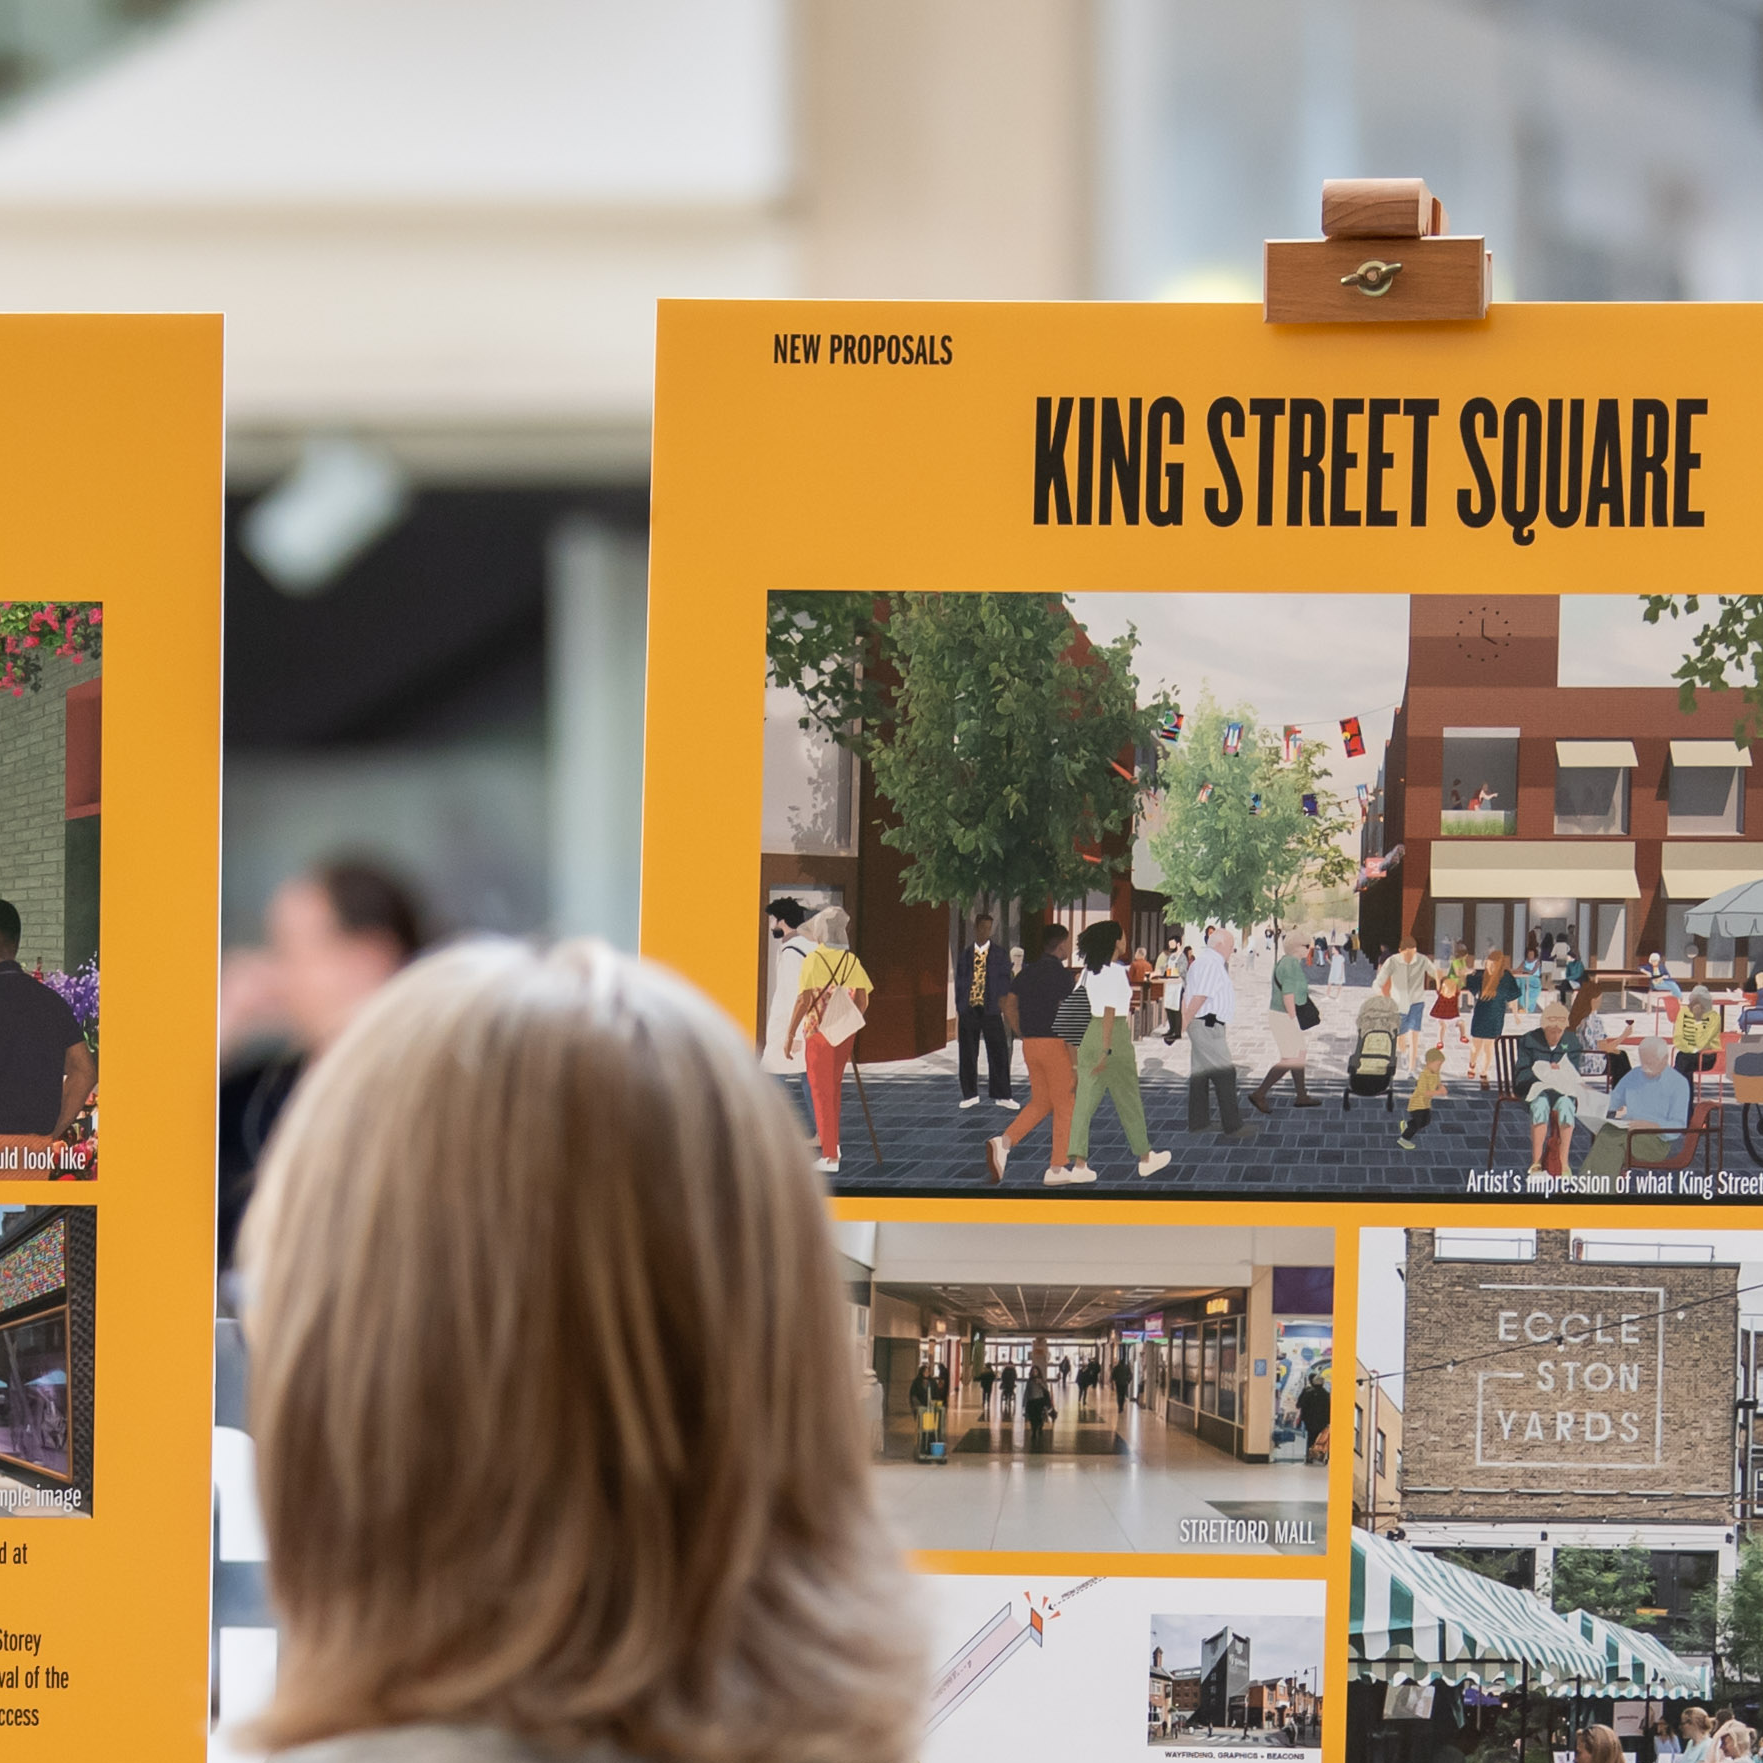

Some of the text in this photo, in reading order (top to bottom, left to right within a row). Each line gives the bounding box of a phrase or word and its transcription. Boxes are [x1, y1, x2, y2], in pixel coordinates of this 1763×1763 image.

[773, 333, 952, 365] NEW PROPOSALS
[1033, 395, 1708, 547] KING STREET SQUARE
[23, 1147, 56, 1172] look
[60, 1147, 86, 1172] like
[1525, 1169, 1610, 1198] impression
[1615, 1170, 1631, 1193] of
[1636, 1170, 1673, 1194] what
[1679, 1170, 1713, 1199] King
[1717, 1170, 1763, 1194] Street
[1498, 1311, 1641, 1344] ECCLE
[1537, 1361, 1639, 1392] STON
[1497, 1410, 1639, 1443] YARDS
[36, 1483, 82, 1513] image
[1179, 1519, 1316, 1545] STRETFORD MALL
[12, 1543, 27, 1564] at
[1217, 1751, 1258, 1759] GRAPHICS
[1266, 1752, 1304, 1760] BEACONS
